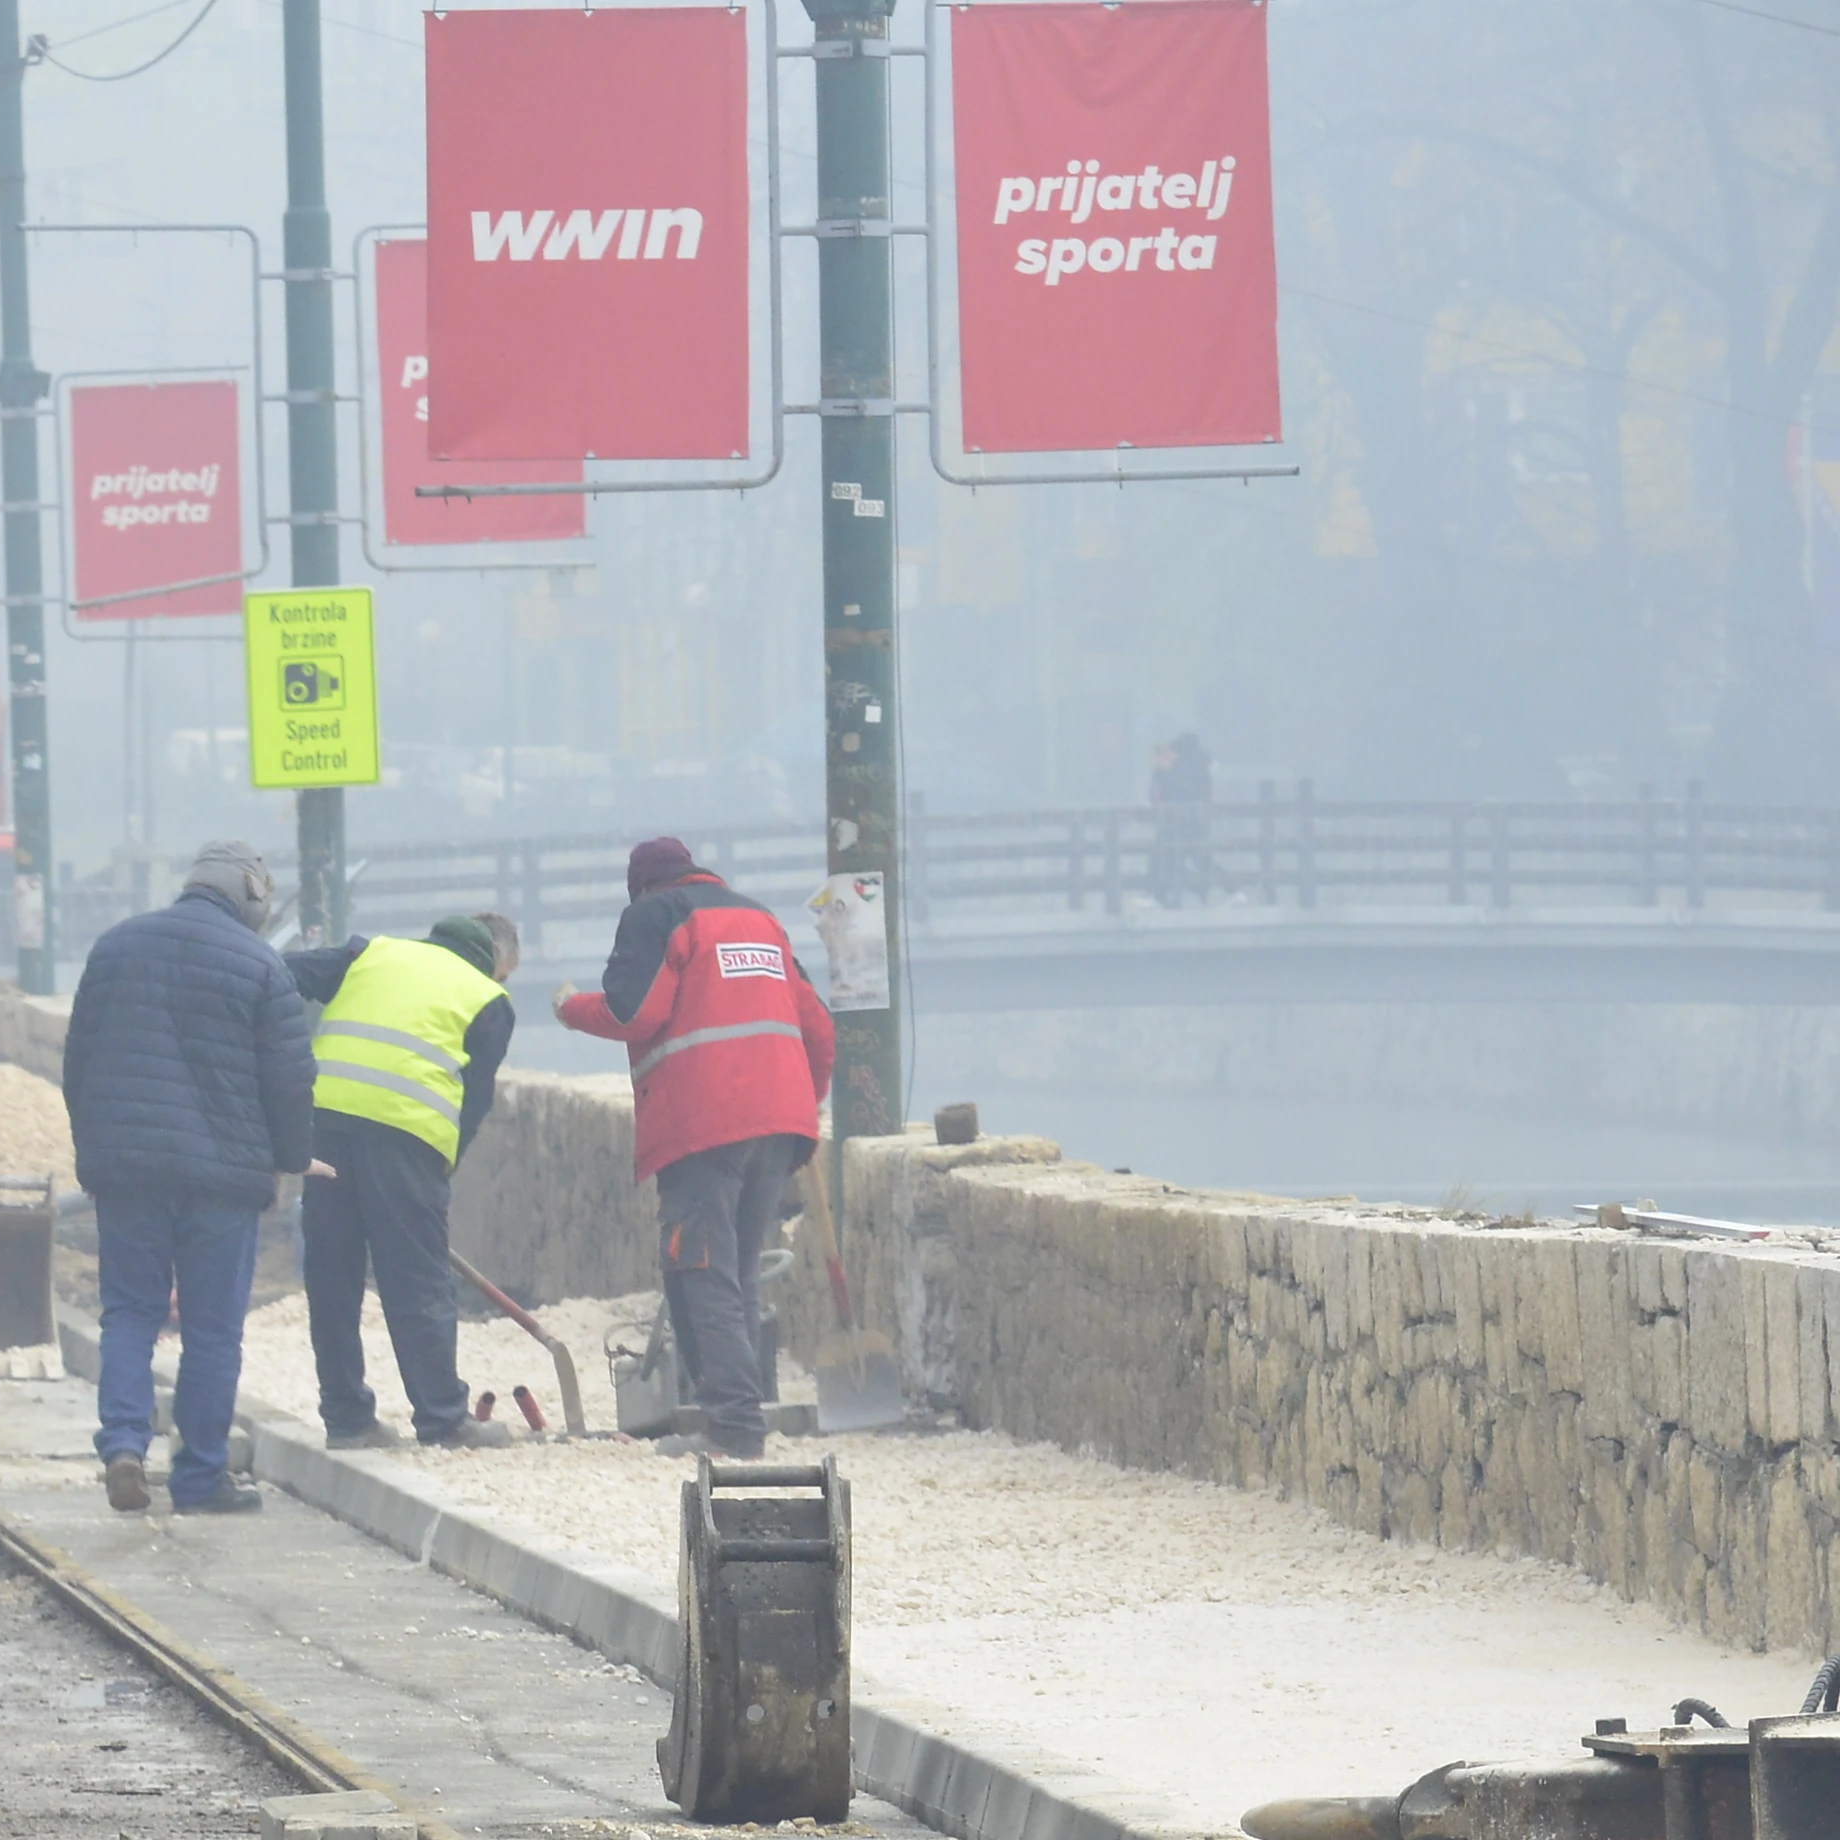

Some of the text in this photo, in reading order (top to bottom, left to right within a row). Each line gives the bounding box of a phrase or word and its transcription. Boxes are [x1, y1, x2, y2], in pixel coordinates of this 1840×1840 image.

[993, 155, 1237, 225] prijatelj
[1014, 227, 1218, 286] sporta
[90, 463, 221, 500] prijatelj
[101, 499, 211, 531] sporta
[269, 601, 347, 624] Kontrola
[281, 627, 337, 649] brzine
[285, 716, 341, 746] Speed
[281, 748, 348, 771] Control
